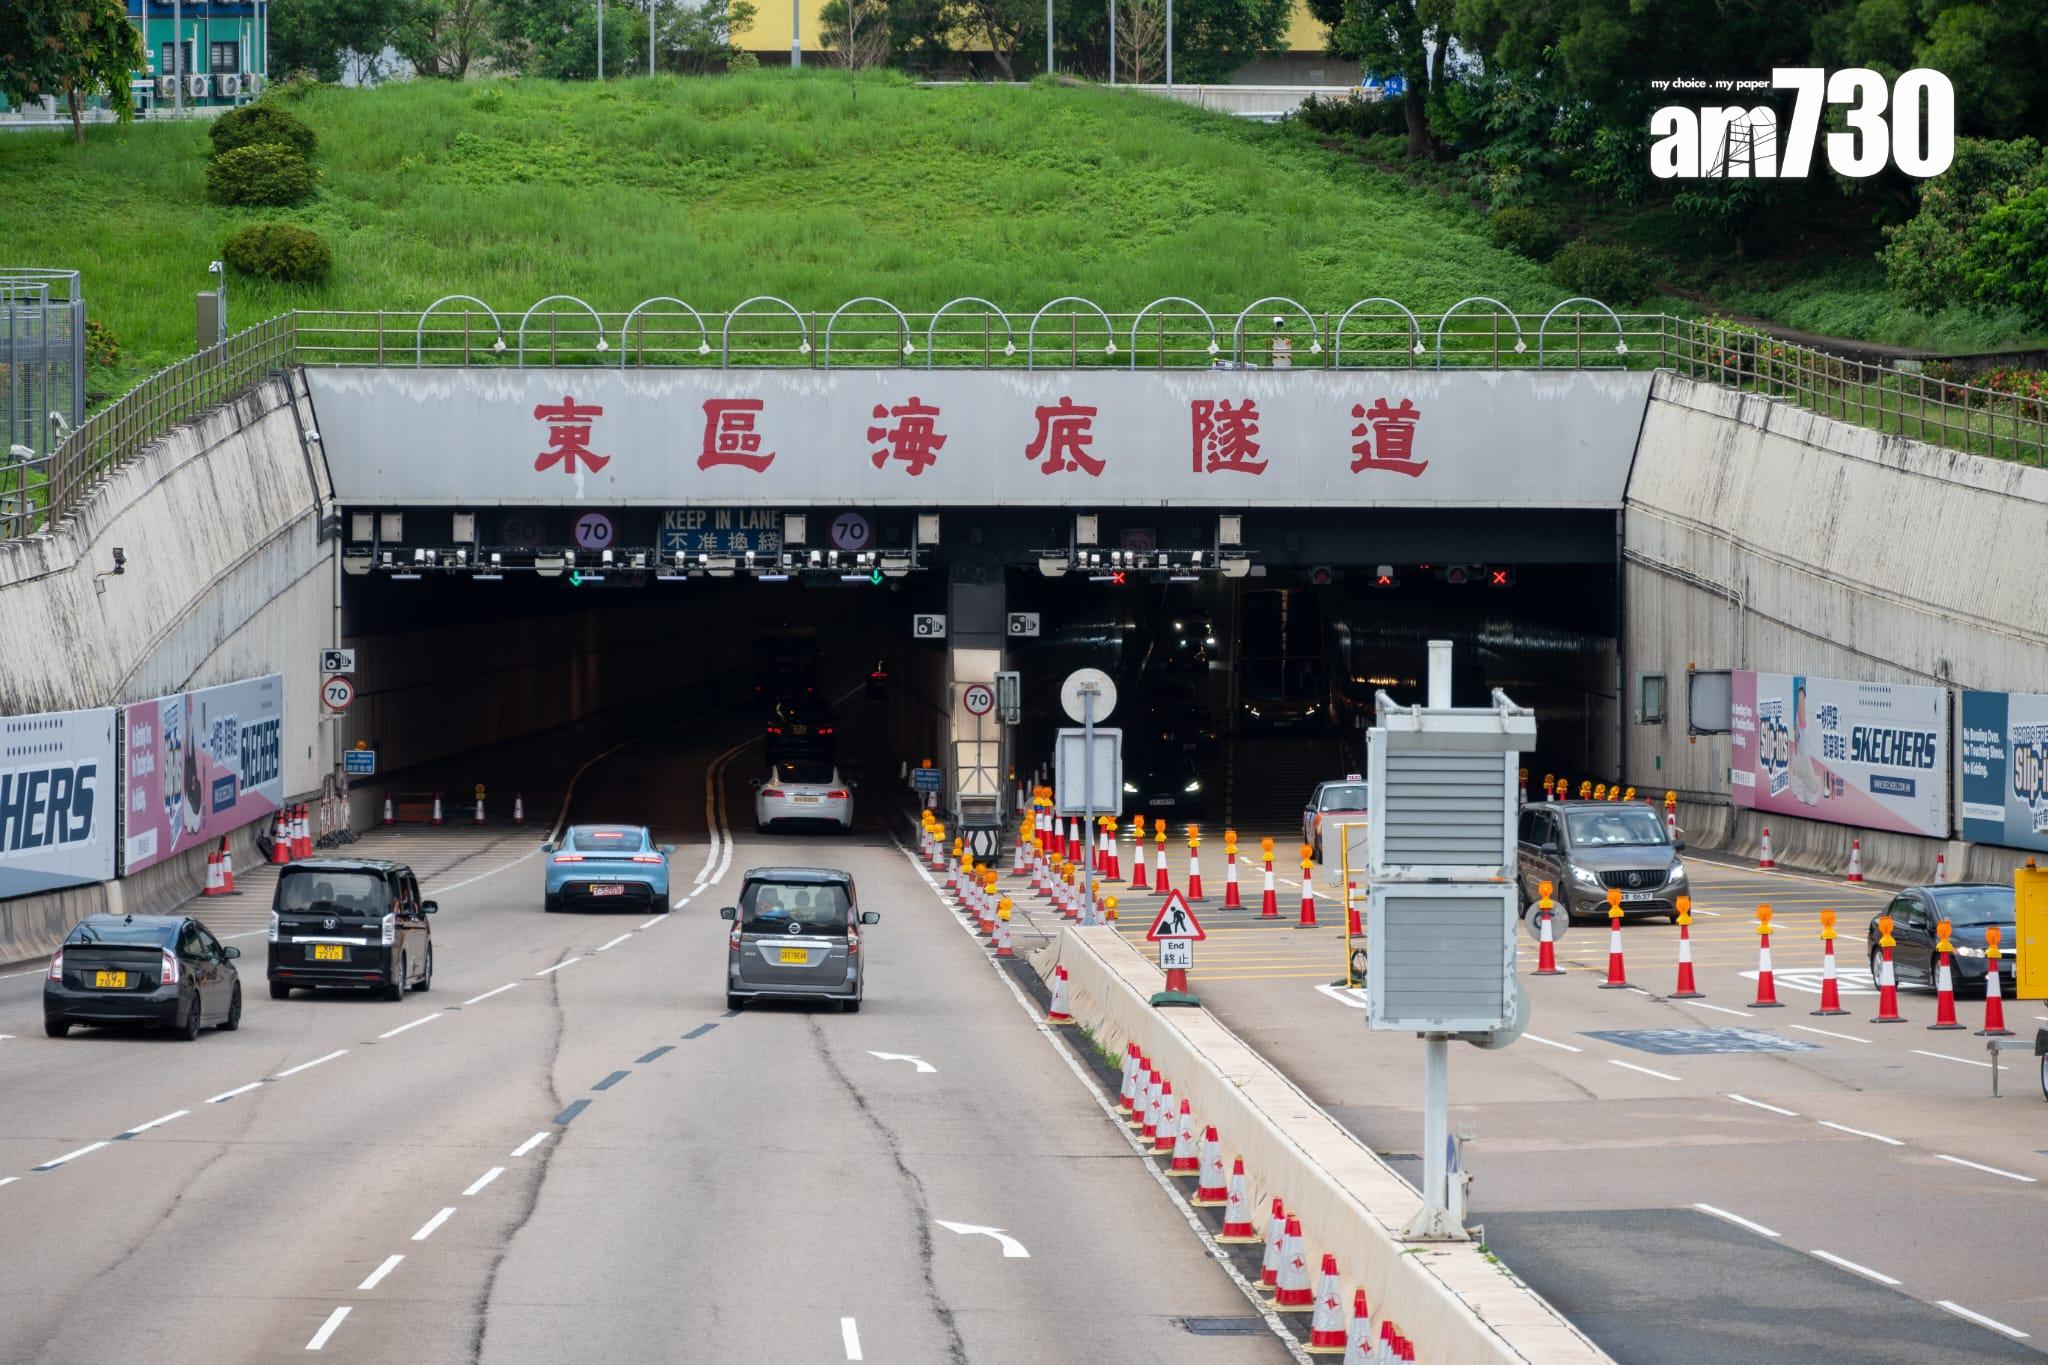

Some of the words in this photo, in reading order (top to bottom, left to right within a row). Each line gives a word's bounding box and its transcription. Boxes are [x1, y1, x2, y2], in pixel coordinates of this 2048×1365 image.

[533, 396, 1427, 476] 東區海底隧道
[665, 510, 706, 530] KEEP
[715, 510, 731, 530] IN
[739, 510, 780, 530] LANE
[580, 523, 608, 541] 70
[836, 523, 865, 540] 70
[328, 688, 348, 700] 70
[969, 694, 989, 706] 70
[240, 718, 280, 790] SKECHERS
[1851, 726, 1937, 770] SKECHERS
[1168, 942, 1185, 950] End
[1164, 953, 1189, 965] 終止
